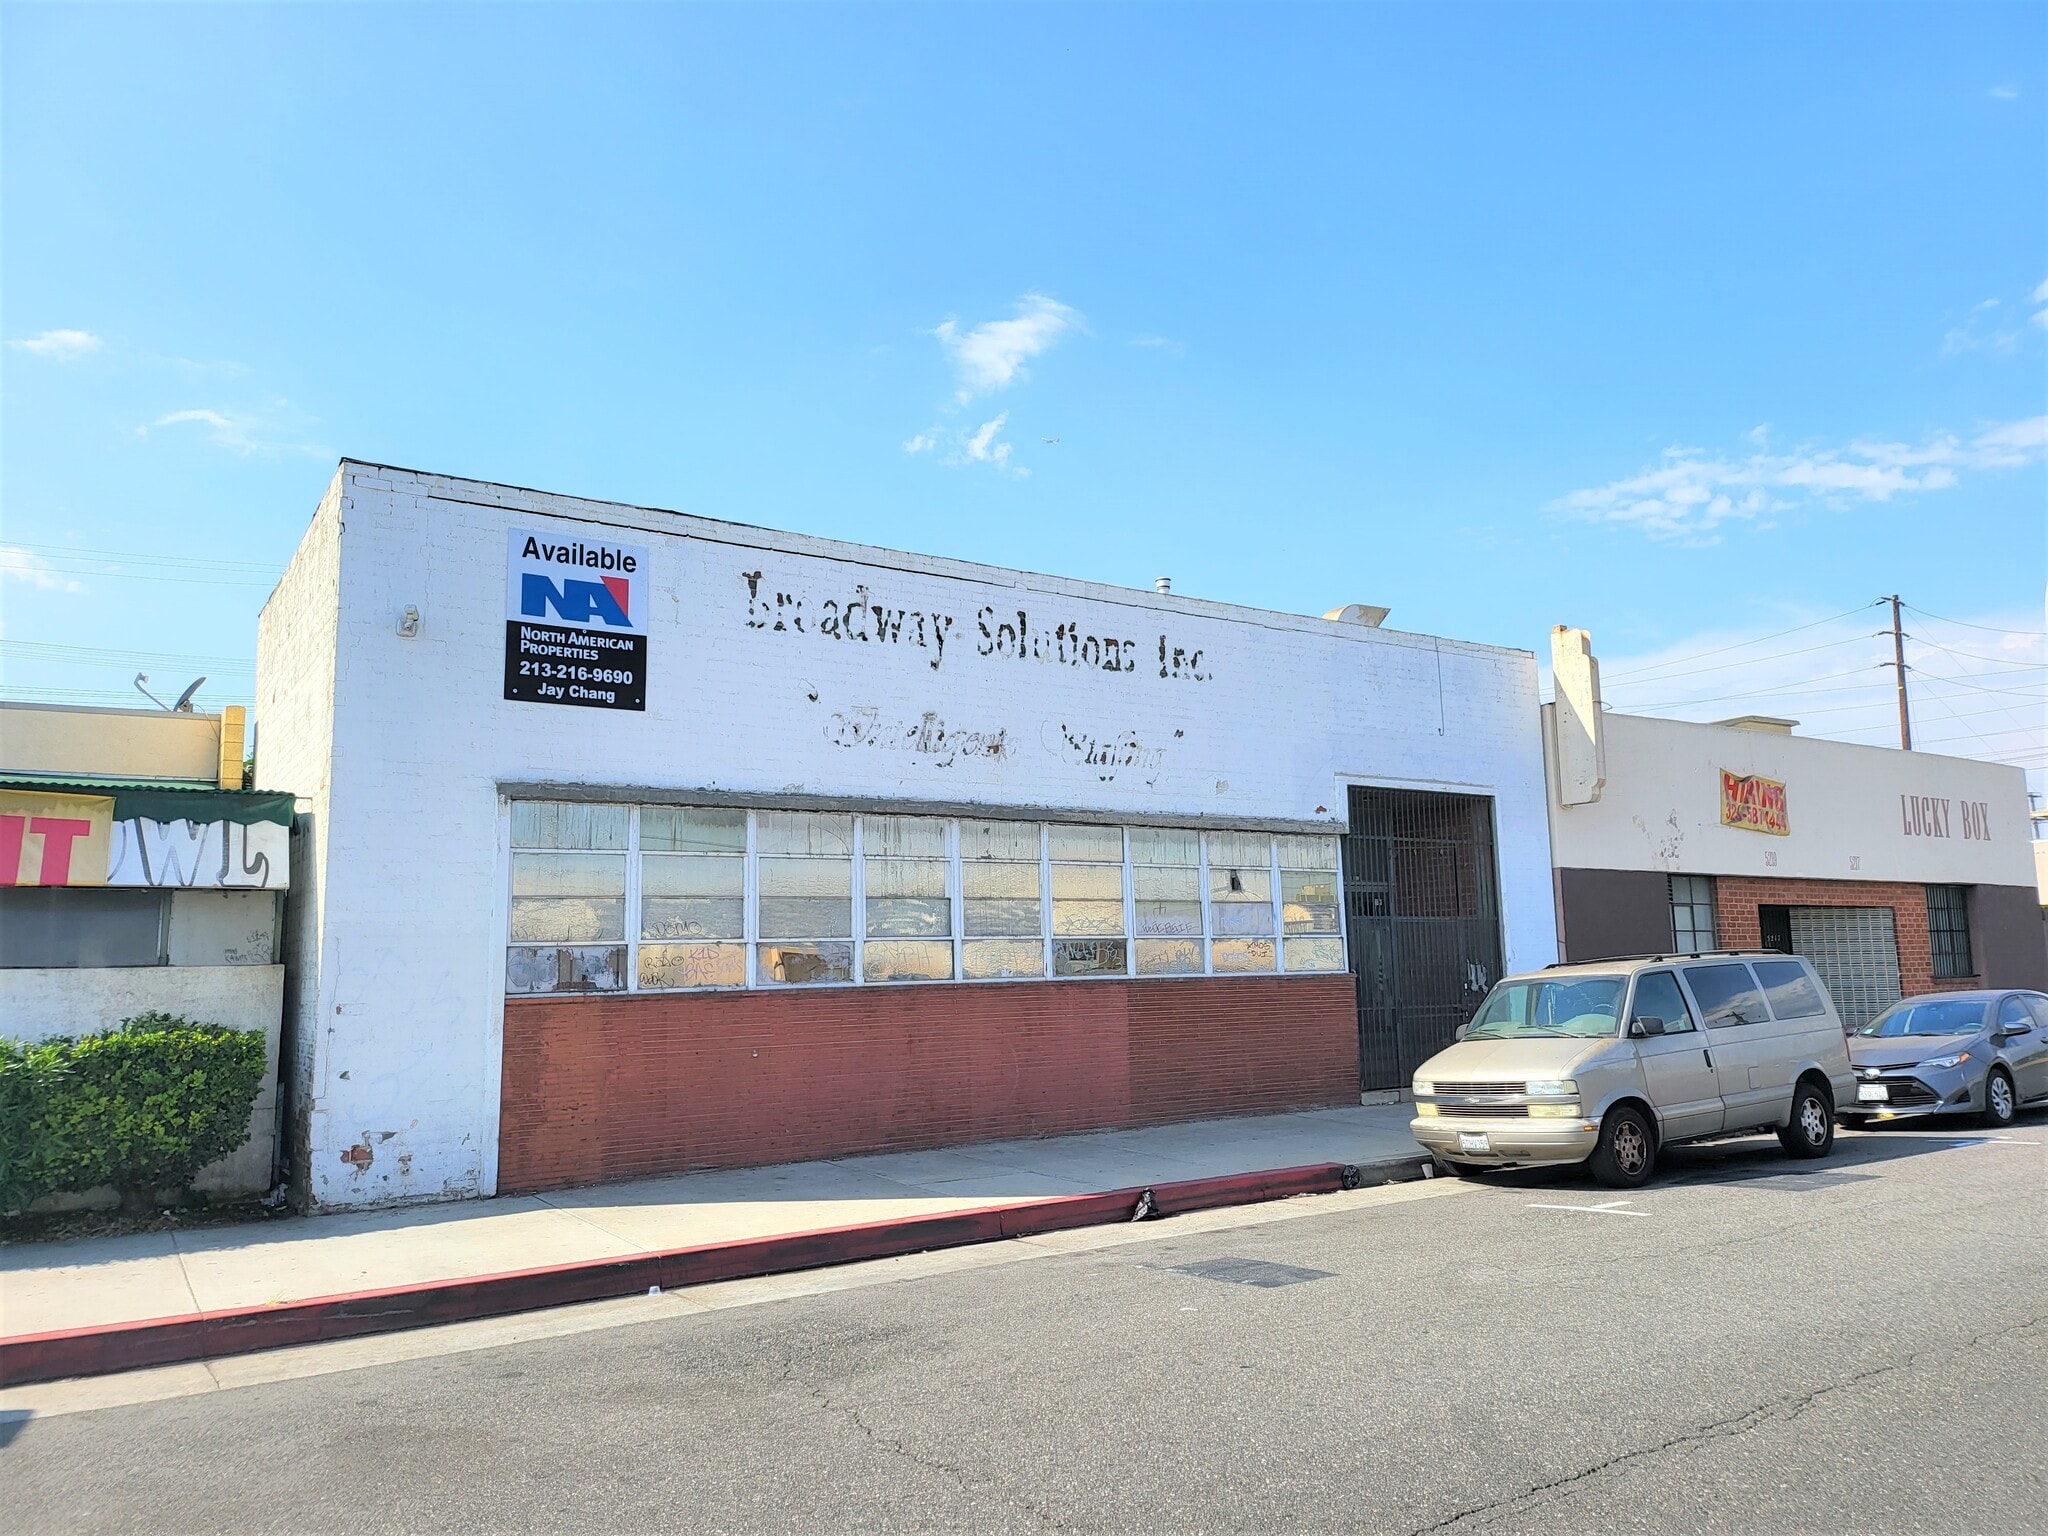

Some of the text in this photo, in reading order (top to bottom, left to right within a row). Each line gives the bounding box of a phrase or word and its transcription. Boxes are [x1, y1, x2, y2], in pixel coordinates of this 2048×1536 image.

[522, 537, 637, 573] Available
[520, 626, 634, 651] NORTH AMERICAN
[520, 640, 599, 661] PROPERTIES
[519, 661, 634, 685] 213-216-9690
[537, 682, 616, 704] Jay Chang
[1900, 794, 1992, 841] LUCKY BOX
